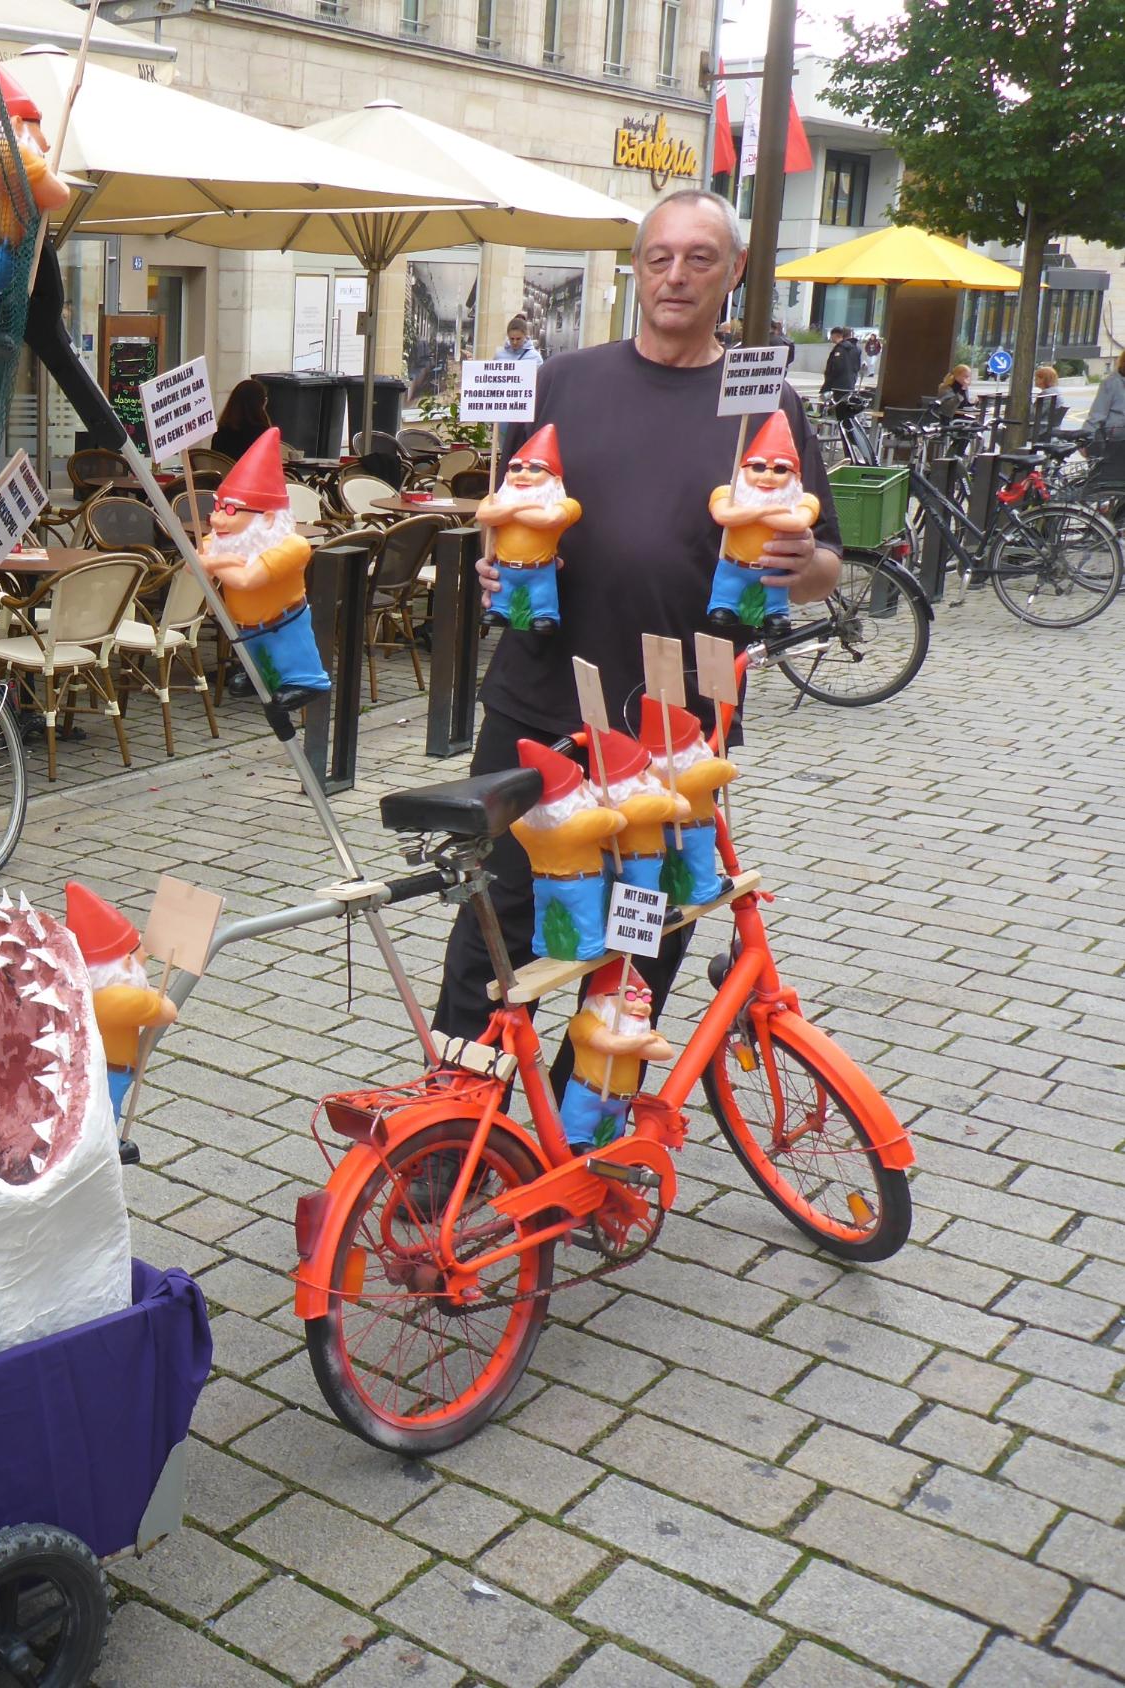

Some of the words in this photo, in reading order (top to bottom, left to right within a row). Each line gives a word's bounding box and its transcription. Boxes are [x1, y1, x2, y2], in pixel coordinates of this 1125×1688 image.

[730, 352, 742, 364] ICH
[743, 351, 759, 363] WILL
[761, 351, 775, 361] DAS
[484, 362, 503, 371] HILFE
[504, 362, 515, 371] BEI
[726, 368, 751, 379] ZOCKEN
[750, 366, 783, 377] AUFHÖREN
[155, 366, 194, 393] SPIELHALLEN
[474, 374, 524, 384] GLÜCKSSPIEL-
[151, 390, 180, 413] BRAUCHE
[180, 386, 192, 399] ICH
[191, 378, 205, 392] GAR
[463, 389, 505, 398] PROBLEMEN
[506, 389, 523, 398] GIBT
[524, 389, 533, 398] ES
[724, 386, 739, 397] WIE
[739, 384, 758, 396] GEHT
[758, 383, 774, 395] DAS
[467, 402, 484, 411] HIER
[485, 402, 493, 411] IN
[494, 402, 508, 411] DER
[509, 400, 527, 411] NÄHE
[155, 410, 173, 430] NICHT
[174, 402, 192, 419] MEHR
[154, 434, 167, 450] ICH
[167, 426, 185, 443] GEHE
[185, 419, 197, 434] INS
[197, 410, 214, 428] NETZ
[624, 888, 637, 901] MIT
[638, 891, 659, 906] EINEM
[646, 912, 663, 926] WAR
[617, 924, 636, 939] ALLES
[637, 928, 653, 943] WEG
